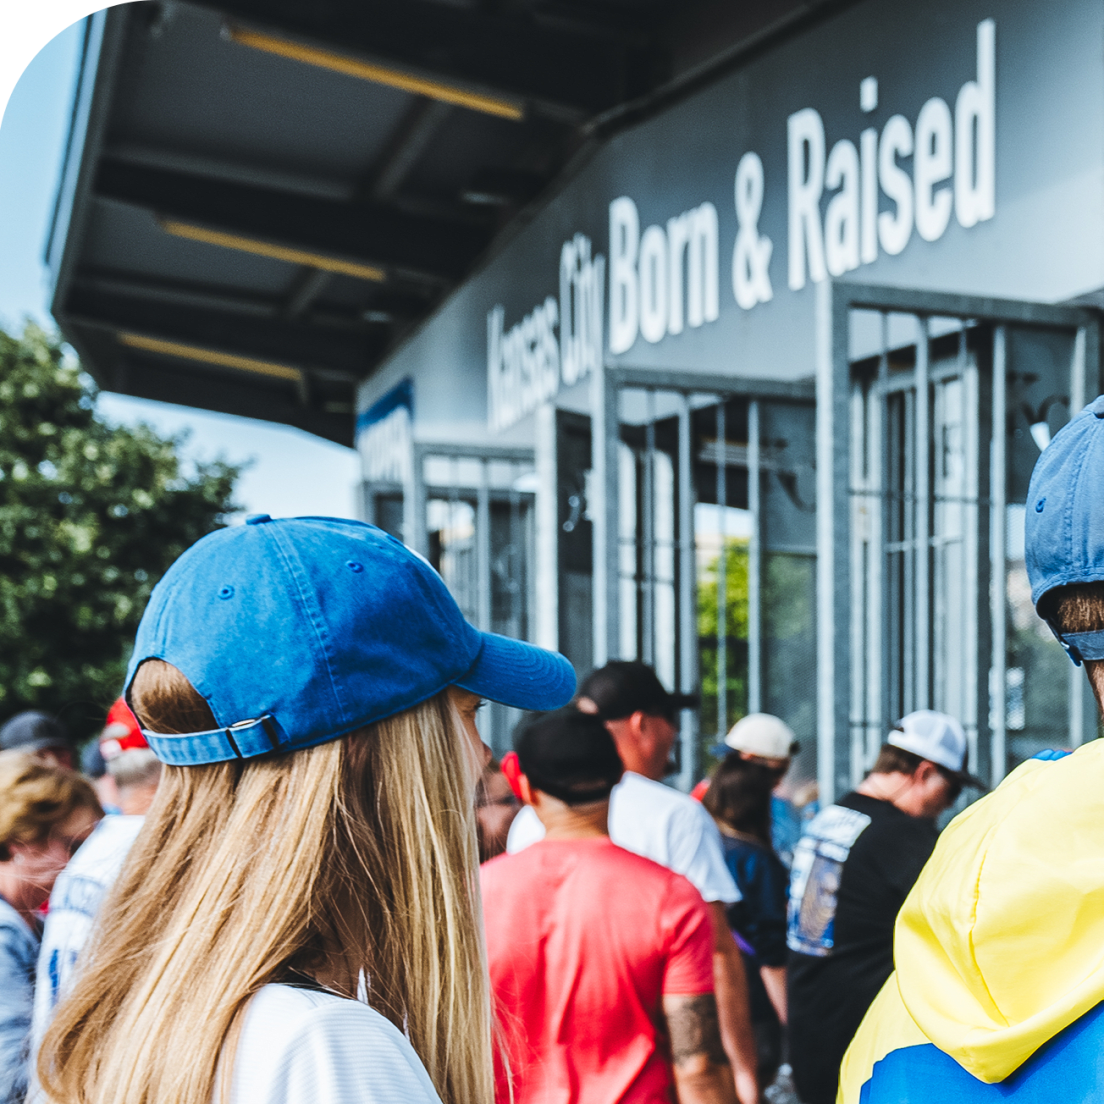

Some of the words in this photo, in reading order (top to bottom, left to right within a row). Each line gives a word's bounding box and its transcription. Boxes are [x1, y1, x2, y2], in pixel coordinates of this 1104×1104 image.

[609, 195, 720, 355] Born
[732, 151, 773, 310] &
[787, 18, 996, 292] Raised
